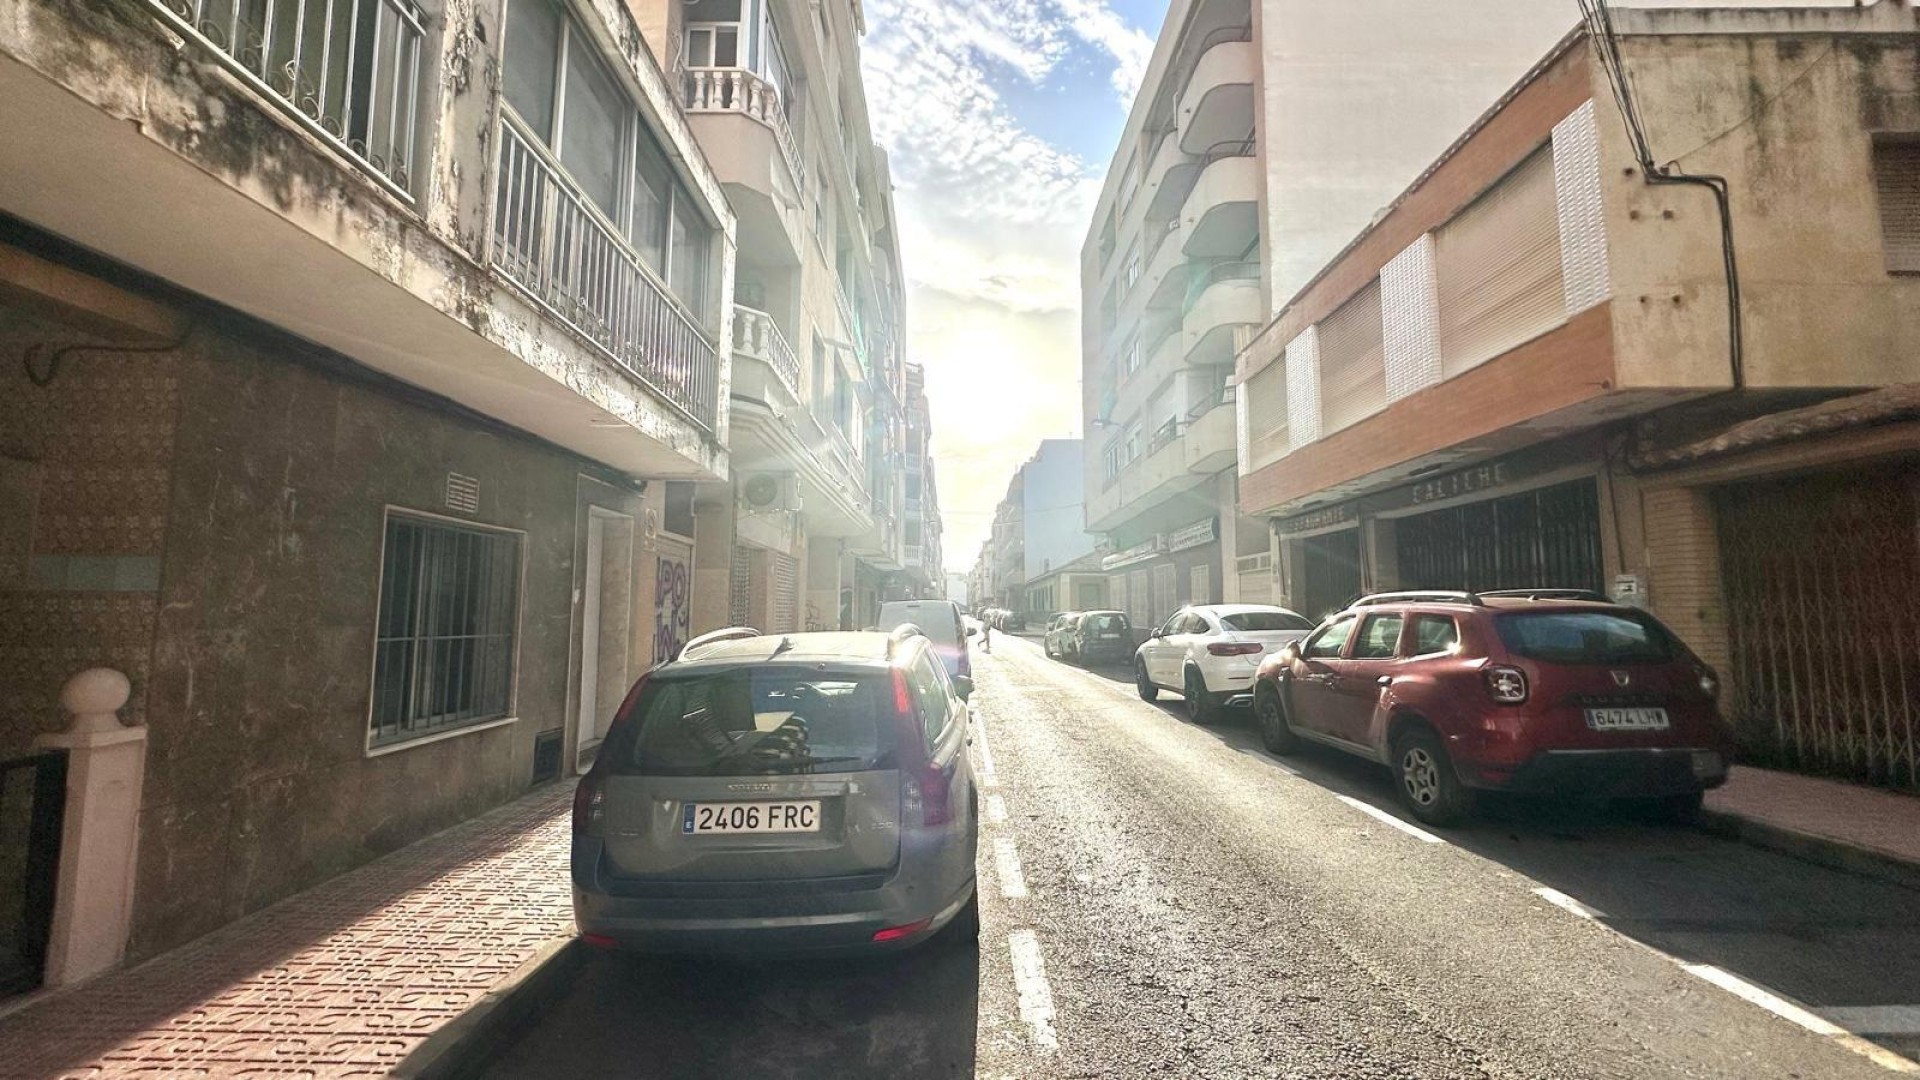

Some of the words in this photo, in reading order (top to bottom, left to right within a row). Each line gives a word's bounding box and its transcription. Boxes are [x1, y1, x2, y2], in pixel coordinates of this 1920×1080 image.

[1595, 710, 1634, 726] 6474
[699, 806, 760, 830] 2406
[767, 804, 814, 829] FRC
